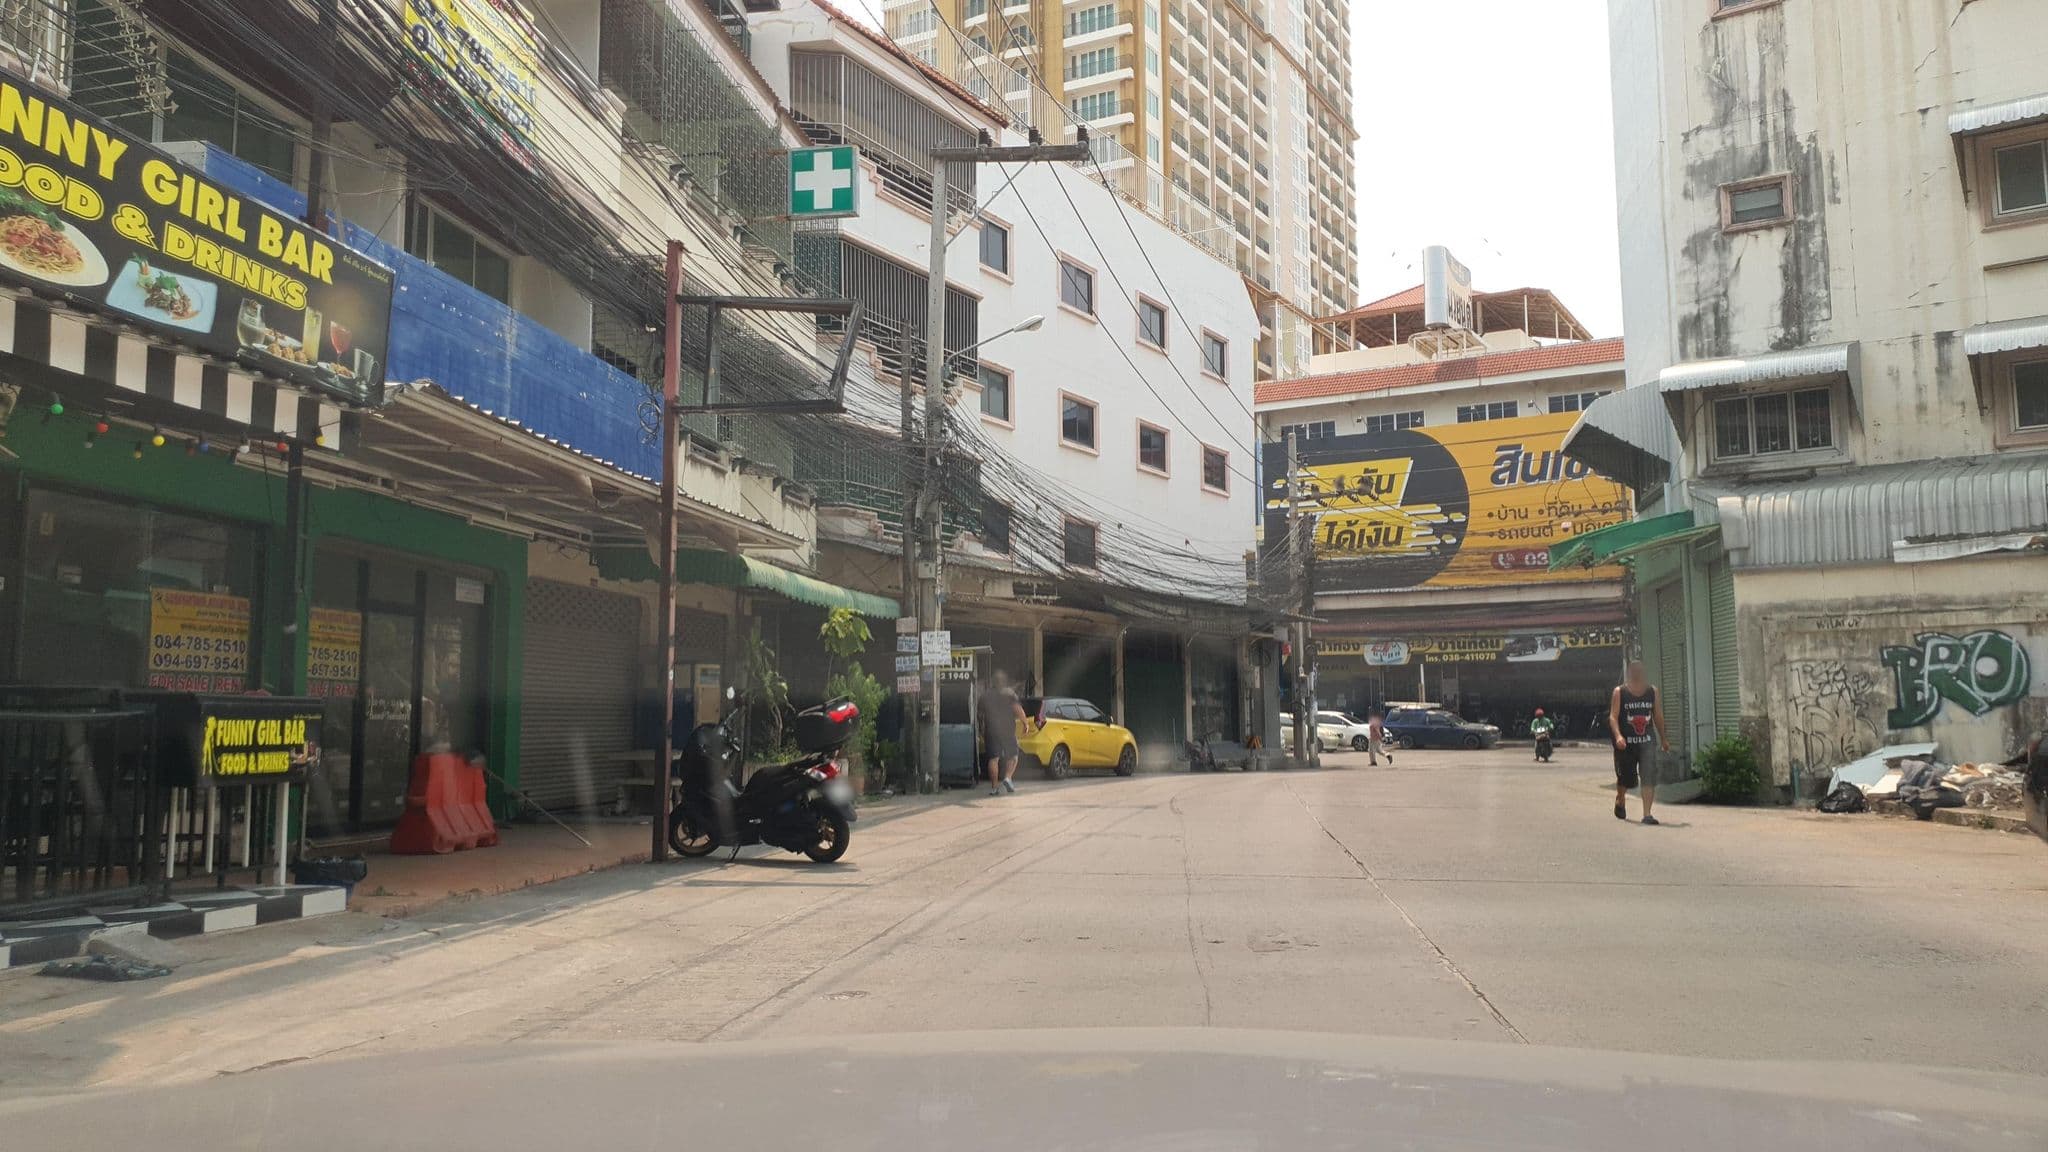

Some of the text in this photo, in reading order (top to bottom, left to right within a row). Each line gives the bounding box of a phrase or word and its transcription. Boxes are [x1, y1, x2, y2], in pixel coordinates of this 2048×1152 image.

[141, 160, 247, 243] GIRL
[258, 214, 335, 285] BAR
[111, 203, 159, 251] &
[162, 221, 310, 311] DRINKS
[1497, 504, 1529, 521] บ้าน
[1324, 520, 1404, 550] ได้เงิน
[1498, 521, 1554, 540] รถยนต์
[154, 634, 248, 654] 084-785-2510
[153, 653, 246, 671] 094-697-9541
[150, 674, 175, 690] FOR
[177, 676, 209, 692] SALE
[216, 719, 306, 746] FUNNY GIRL BAR
[220, 751, 290, 775] FOOD & DRINKS
